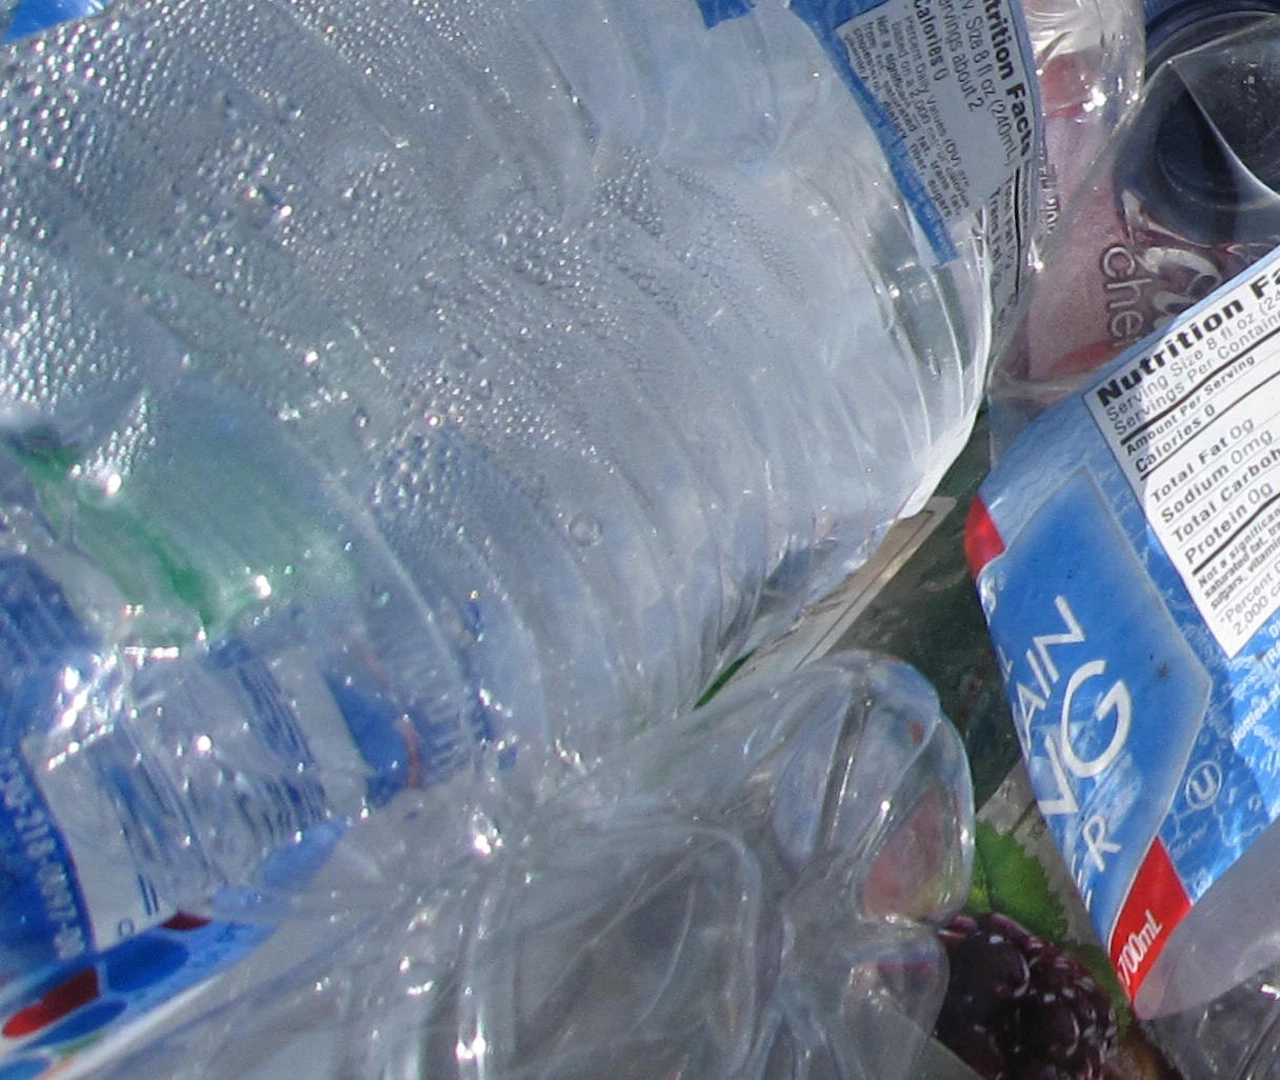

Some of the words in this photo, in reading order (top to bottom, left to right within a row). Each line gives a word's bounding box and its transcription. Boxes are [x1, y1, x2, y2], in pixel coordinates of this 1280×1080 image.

[965, 9, 985, 43] Size
[952, 52, 976, 99] about
[967, 97, 985, 112] 2
[1004, 82, 1032, 158] Facts
[1096, 298, 1244, 408] Nutrition
[1106, 371, 1169, 422] Serving
[1170, 350, 1205, 377] Size
[1112, 383, 1186, 437] Servings
[1188, 358, 1216, 388] Per
[1126, 411, 1179, 456] Amount
[1180, 393, 1202, 418] Per
[1204, 356, 1256, 397] Serving
[1134, 418, 1203, 473] Calories
[1150, 464, 1195, 504] Total
[1198, 438, 1229, 465] Fat
[1161, 464, 1230, 523] Sodium
[1230, 428, 1274, 466] 0mg
[1171, 501, 1217, 544] Total
[1184, 505, 1247, 565] Protein
[1203, 550, 1252, 600] saturated
